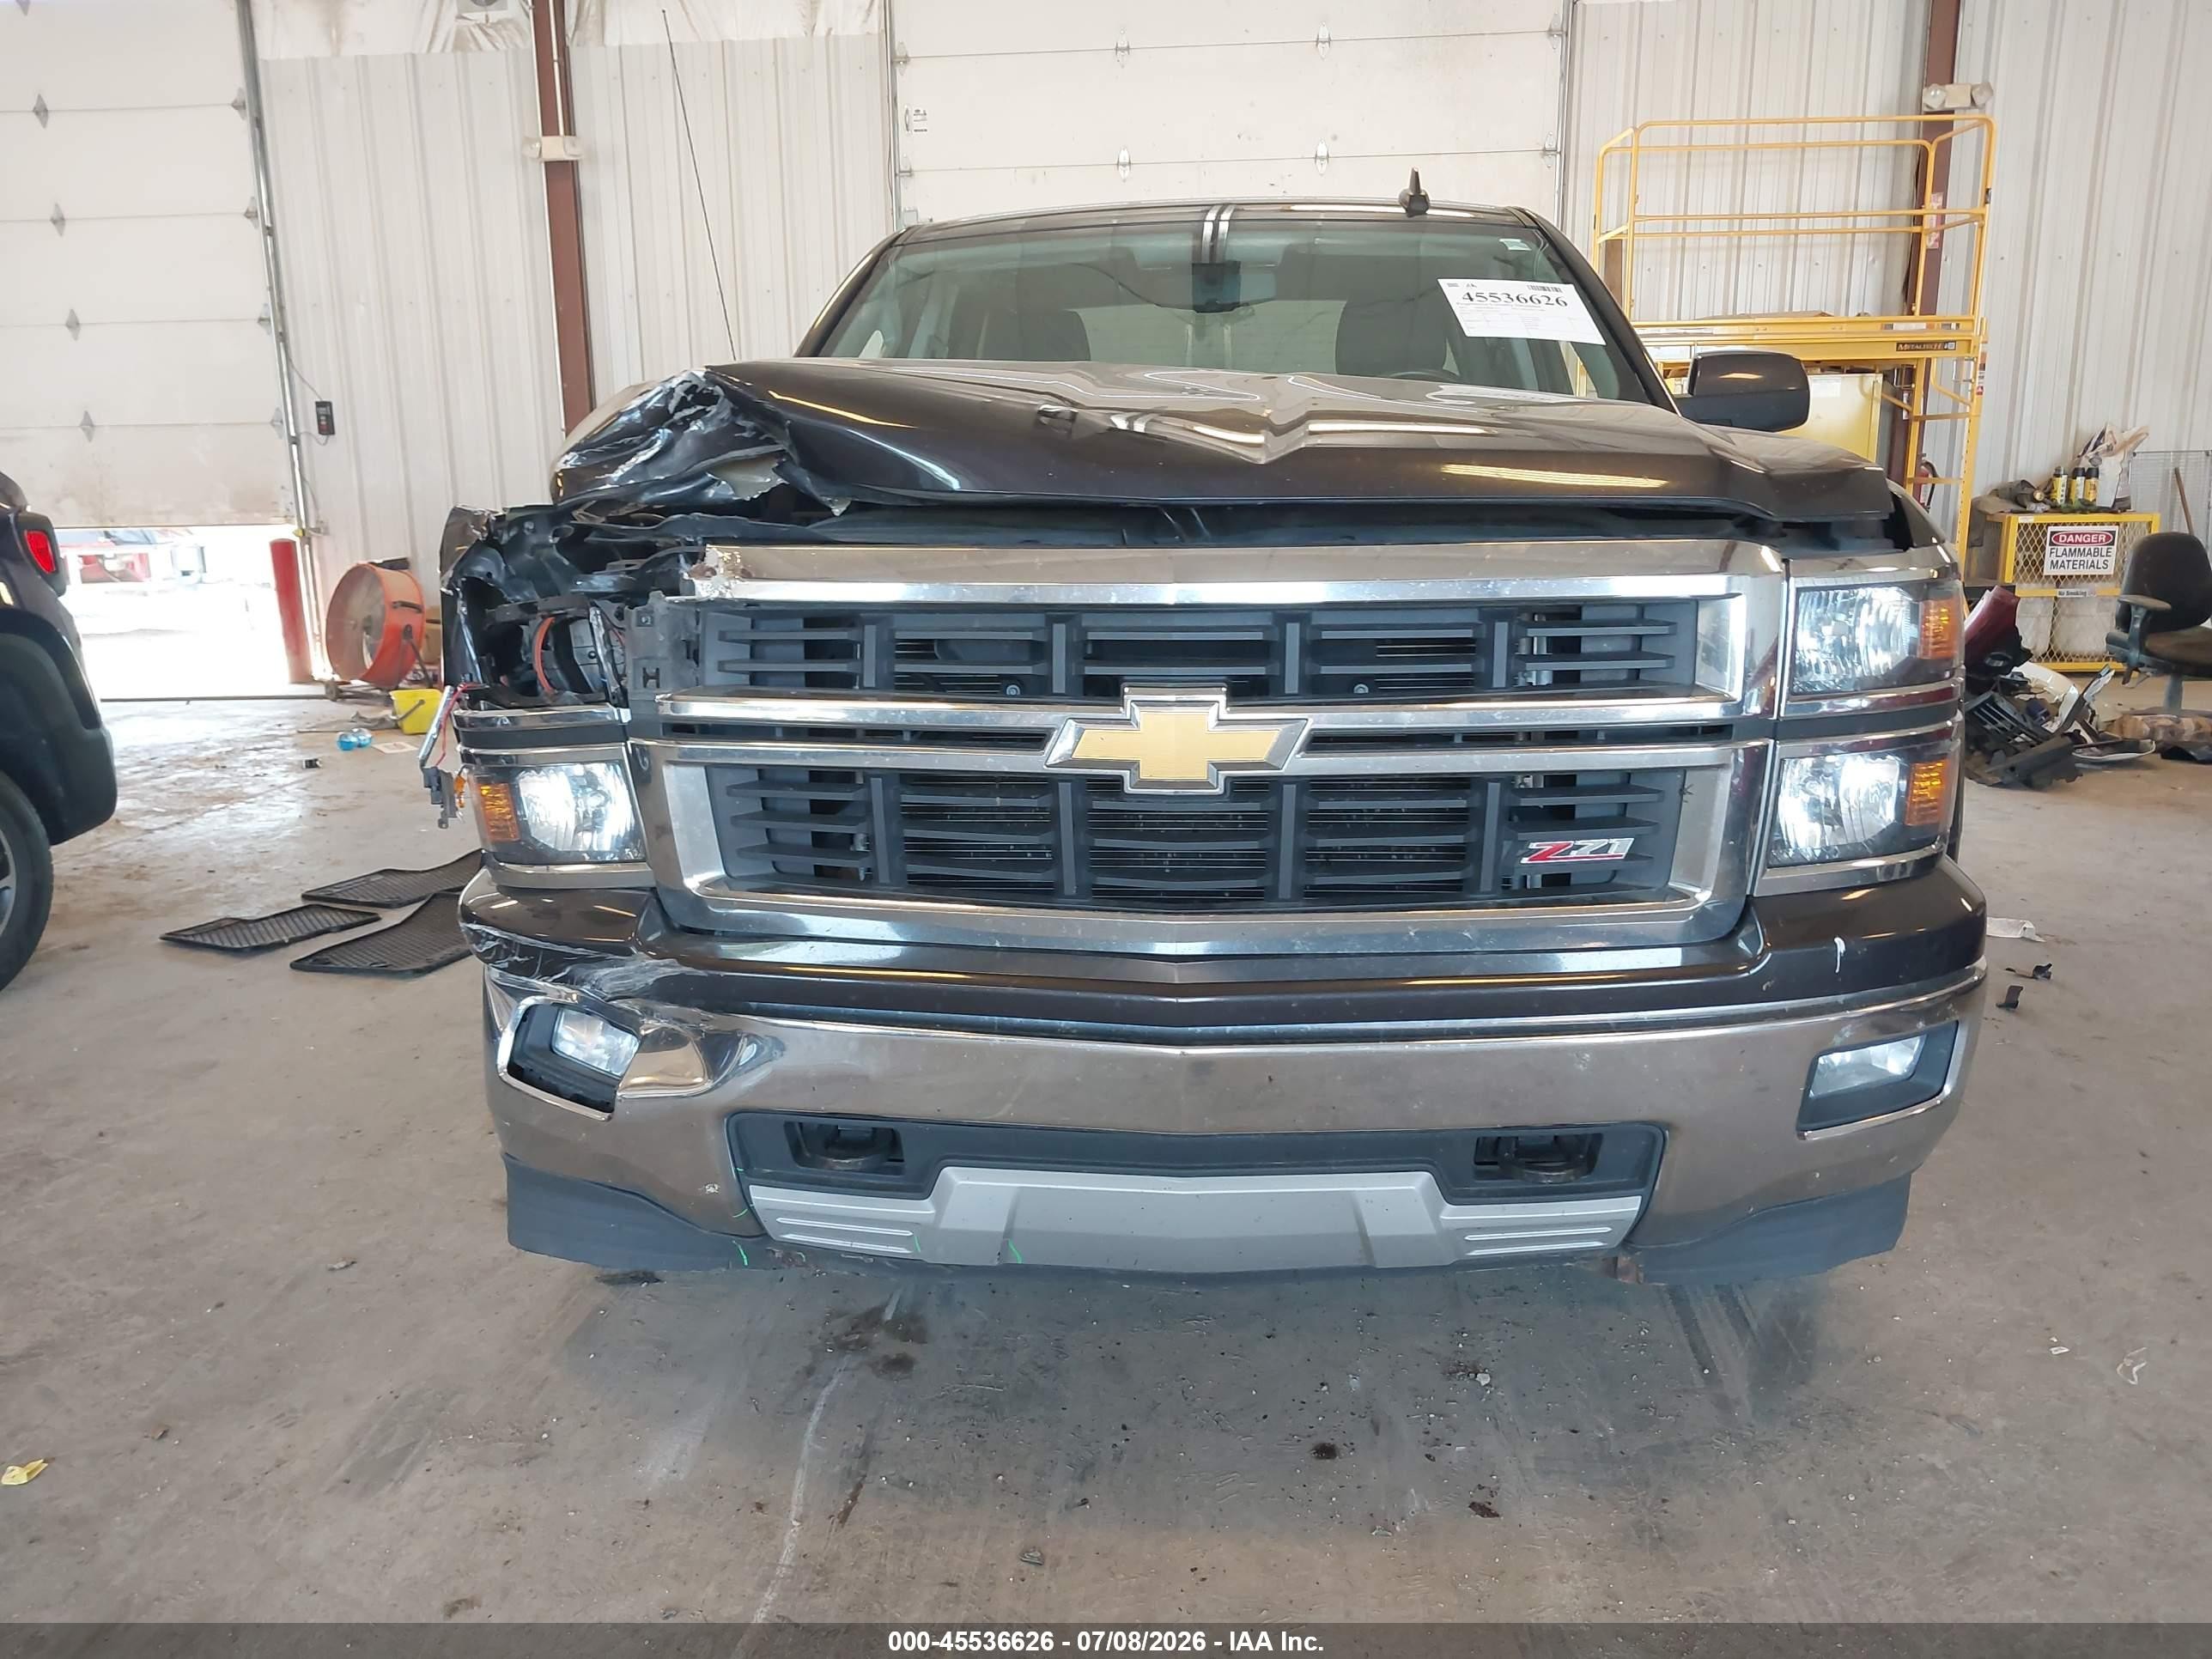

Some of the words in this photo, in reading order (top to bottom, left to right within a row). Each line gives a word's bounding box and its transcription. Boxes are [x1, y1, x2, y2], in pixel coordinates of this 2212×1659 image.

[1462, 291, 1568, 307] 45536626
[2058, 533, 2106, 544] DANGER
[2049, 547, 2112, 558] FLAMMABLE
[2049, 559, 2110, 570] MATERIALS
[1521, 838, 1634, 864] Z71
